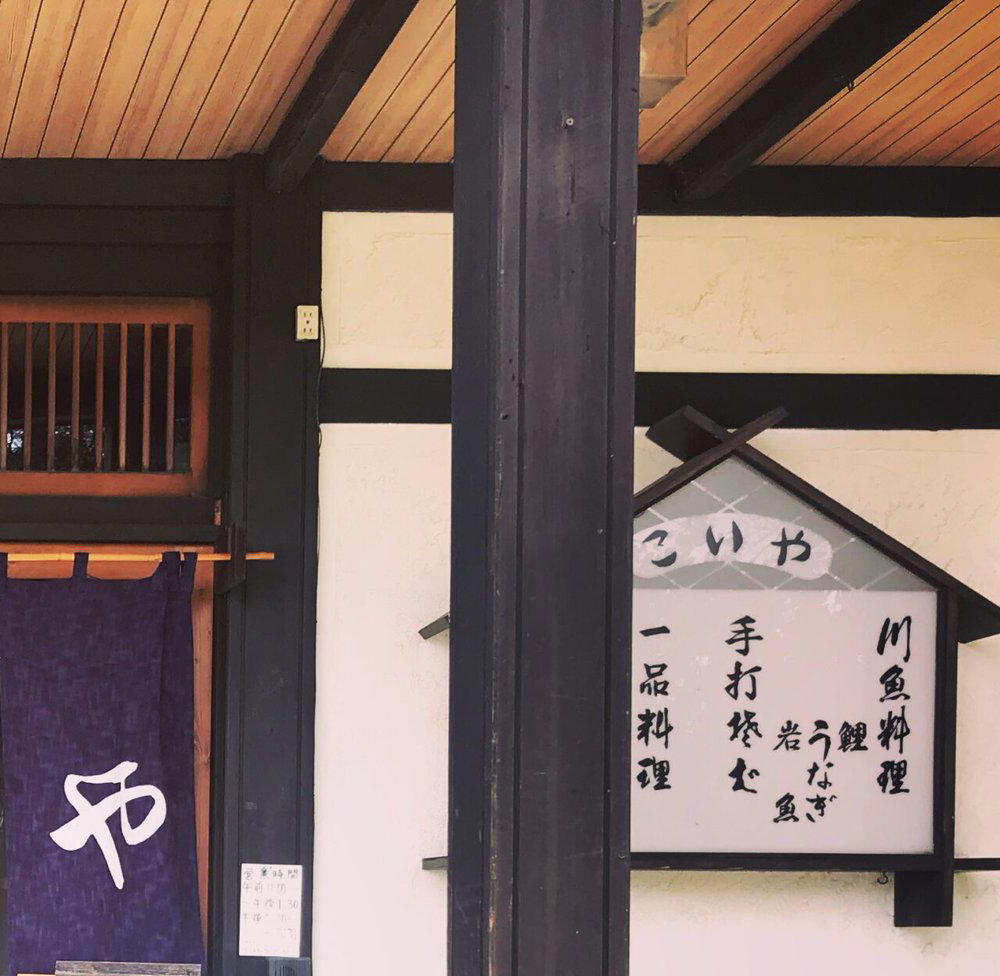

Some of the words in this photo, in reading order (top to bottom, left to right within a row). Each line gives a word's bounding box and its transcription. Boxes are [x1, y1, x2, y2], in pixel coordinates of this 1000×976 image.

[642, 519, 812, 568] こいや
[636, 625, 674, 791] 一品料理
[837, 720, 869, 753] 鯉
[876, 615, 913, 795] 川魚料理
[805, 719, 837, 823] うなぎ
